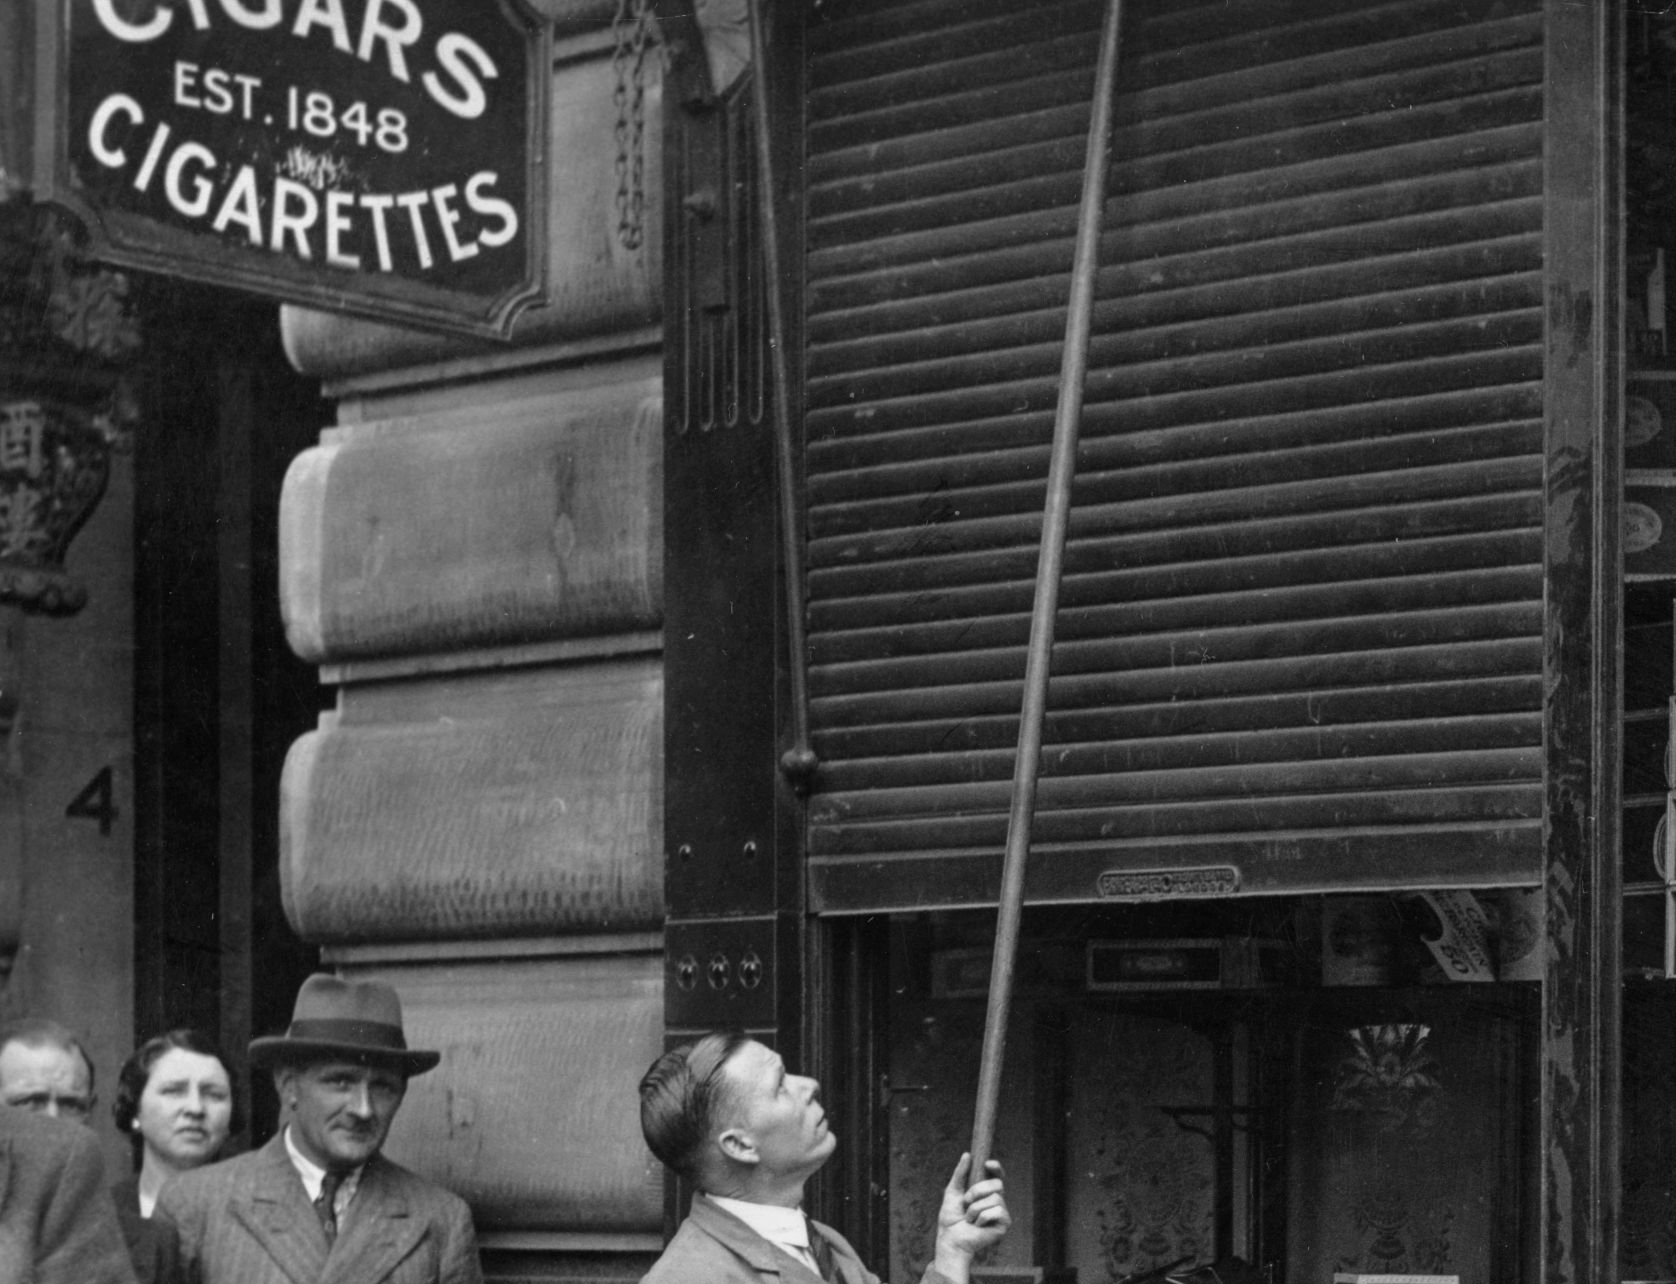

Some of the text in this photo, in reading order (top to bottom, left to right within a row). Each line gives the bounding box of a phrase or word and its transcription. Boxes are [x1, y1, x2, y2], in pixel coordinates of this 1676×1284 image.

[174, 60, 409, 153] EST. 1848
[88, 93, 518, 272] CIGARETTES
[65, 766, 118, 838] 4
